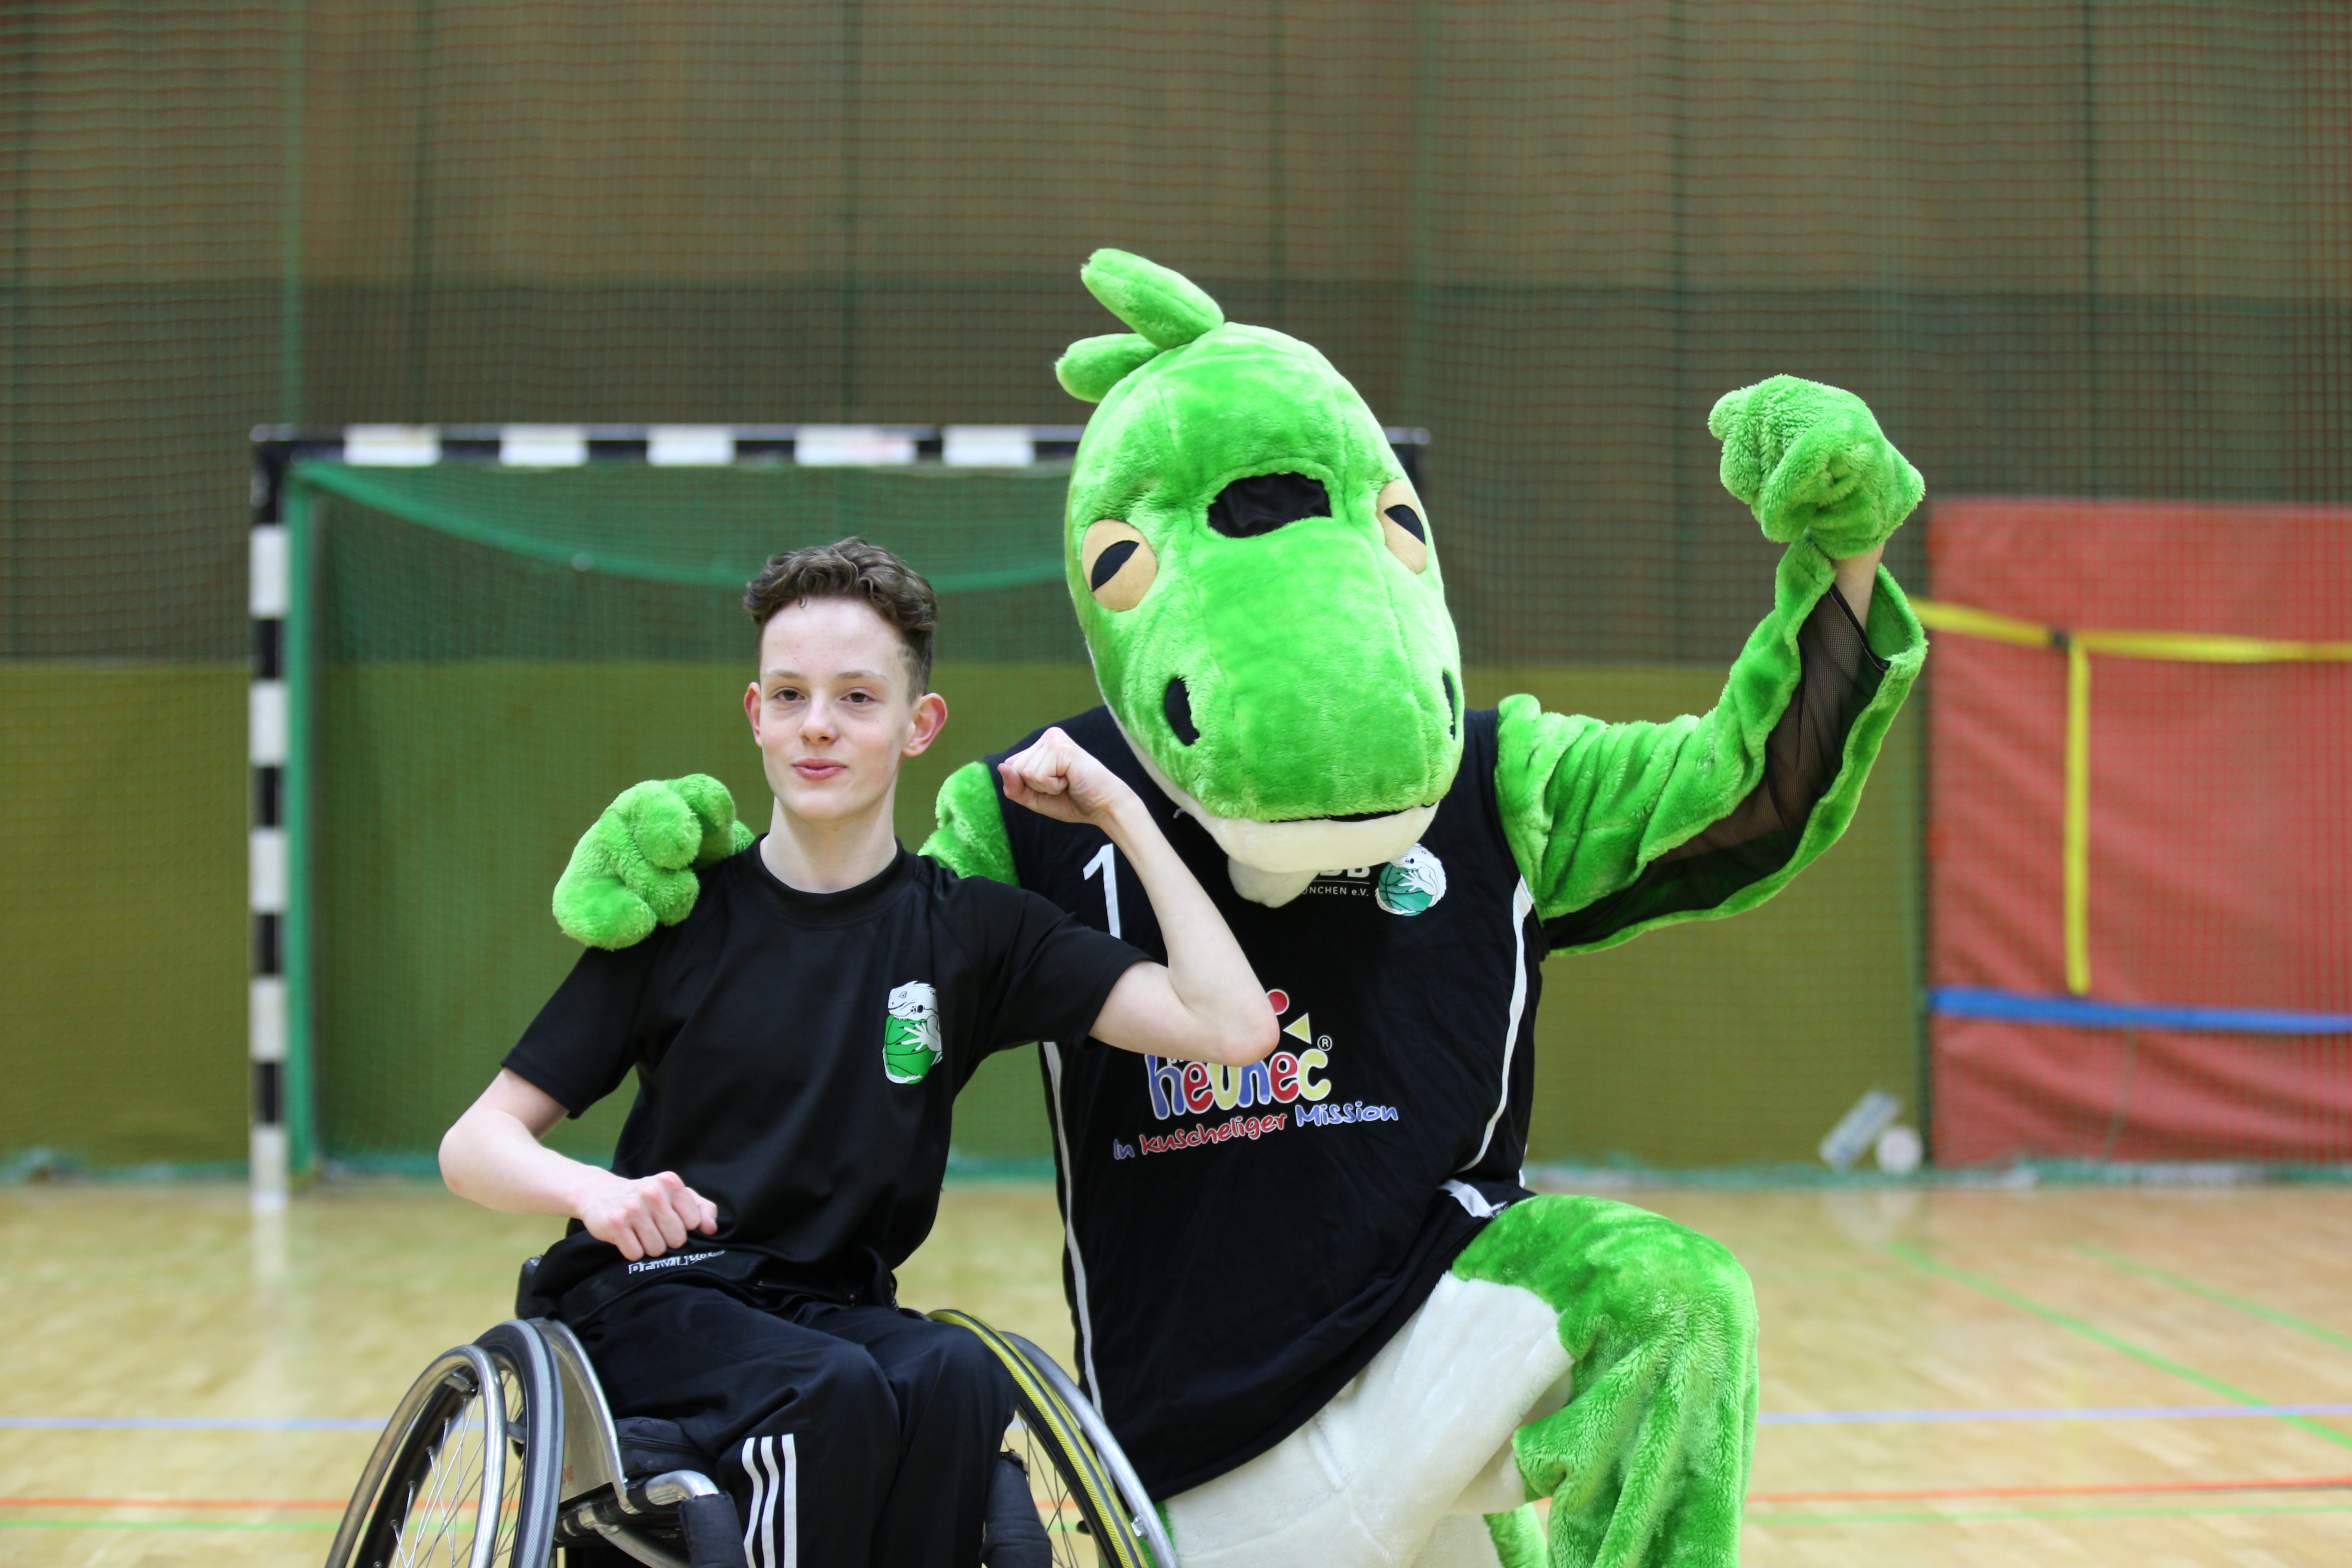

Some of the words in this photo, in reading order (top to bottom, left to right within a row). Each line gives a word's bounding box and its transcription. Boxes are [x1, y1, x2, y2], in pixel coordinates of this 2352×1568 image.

[1082, 843, 1121, 940] 1
[1351, 888, 1369, 897] e.V.
[1113, 1139, 1135, 1160] In
[1139, 1113, 1287, 1155] kuscheliger
[1295, 1101, 1399, 1127] Mission
